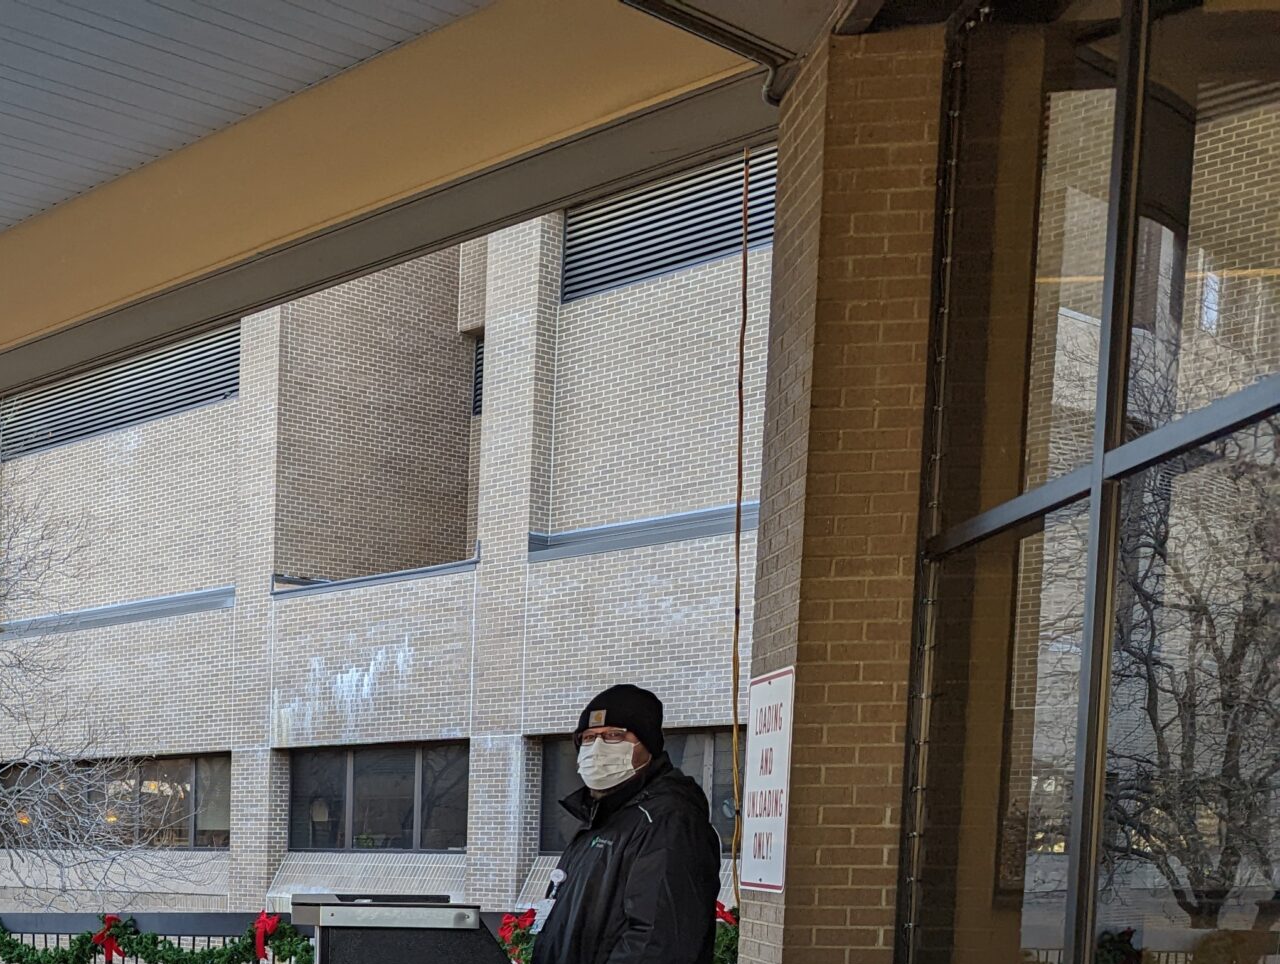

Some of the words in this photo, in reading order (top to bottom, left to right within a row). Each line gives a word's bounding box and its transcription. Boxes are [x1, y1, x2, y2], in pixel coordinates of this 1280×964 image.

[755, 703, 783, 735] LOADING
[759, 748, 773, 776] AND
[747, 789, 783, 818] UNLOADING
[753, 832, 772, 860] ONLY!
